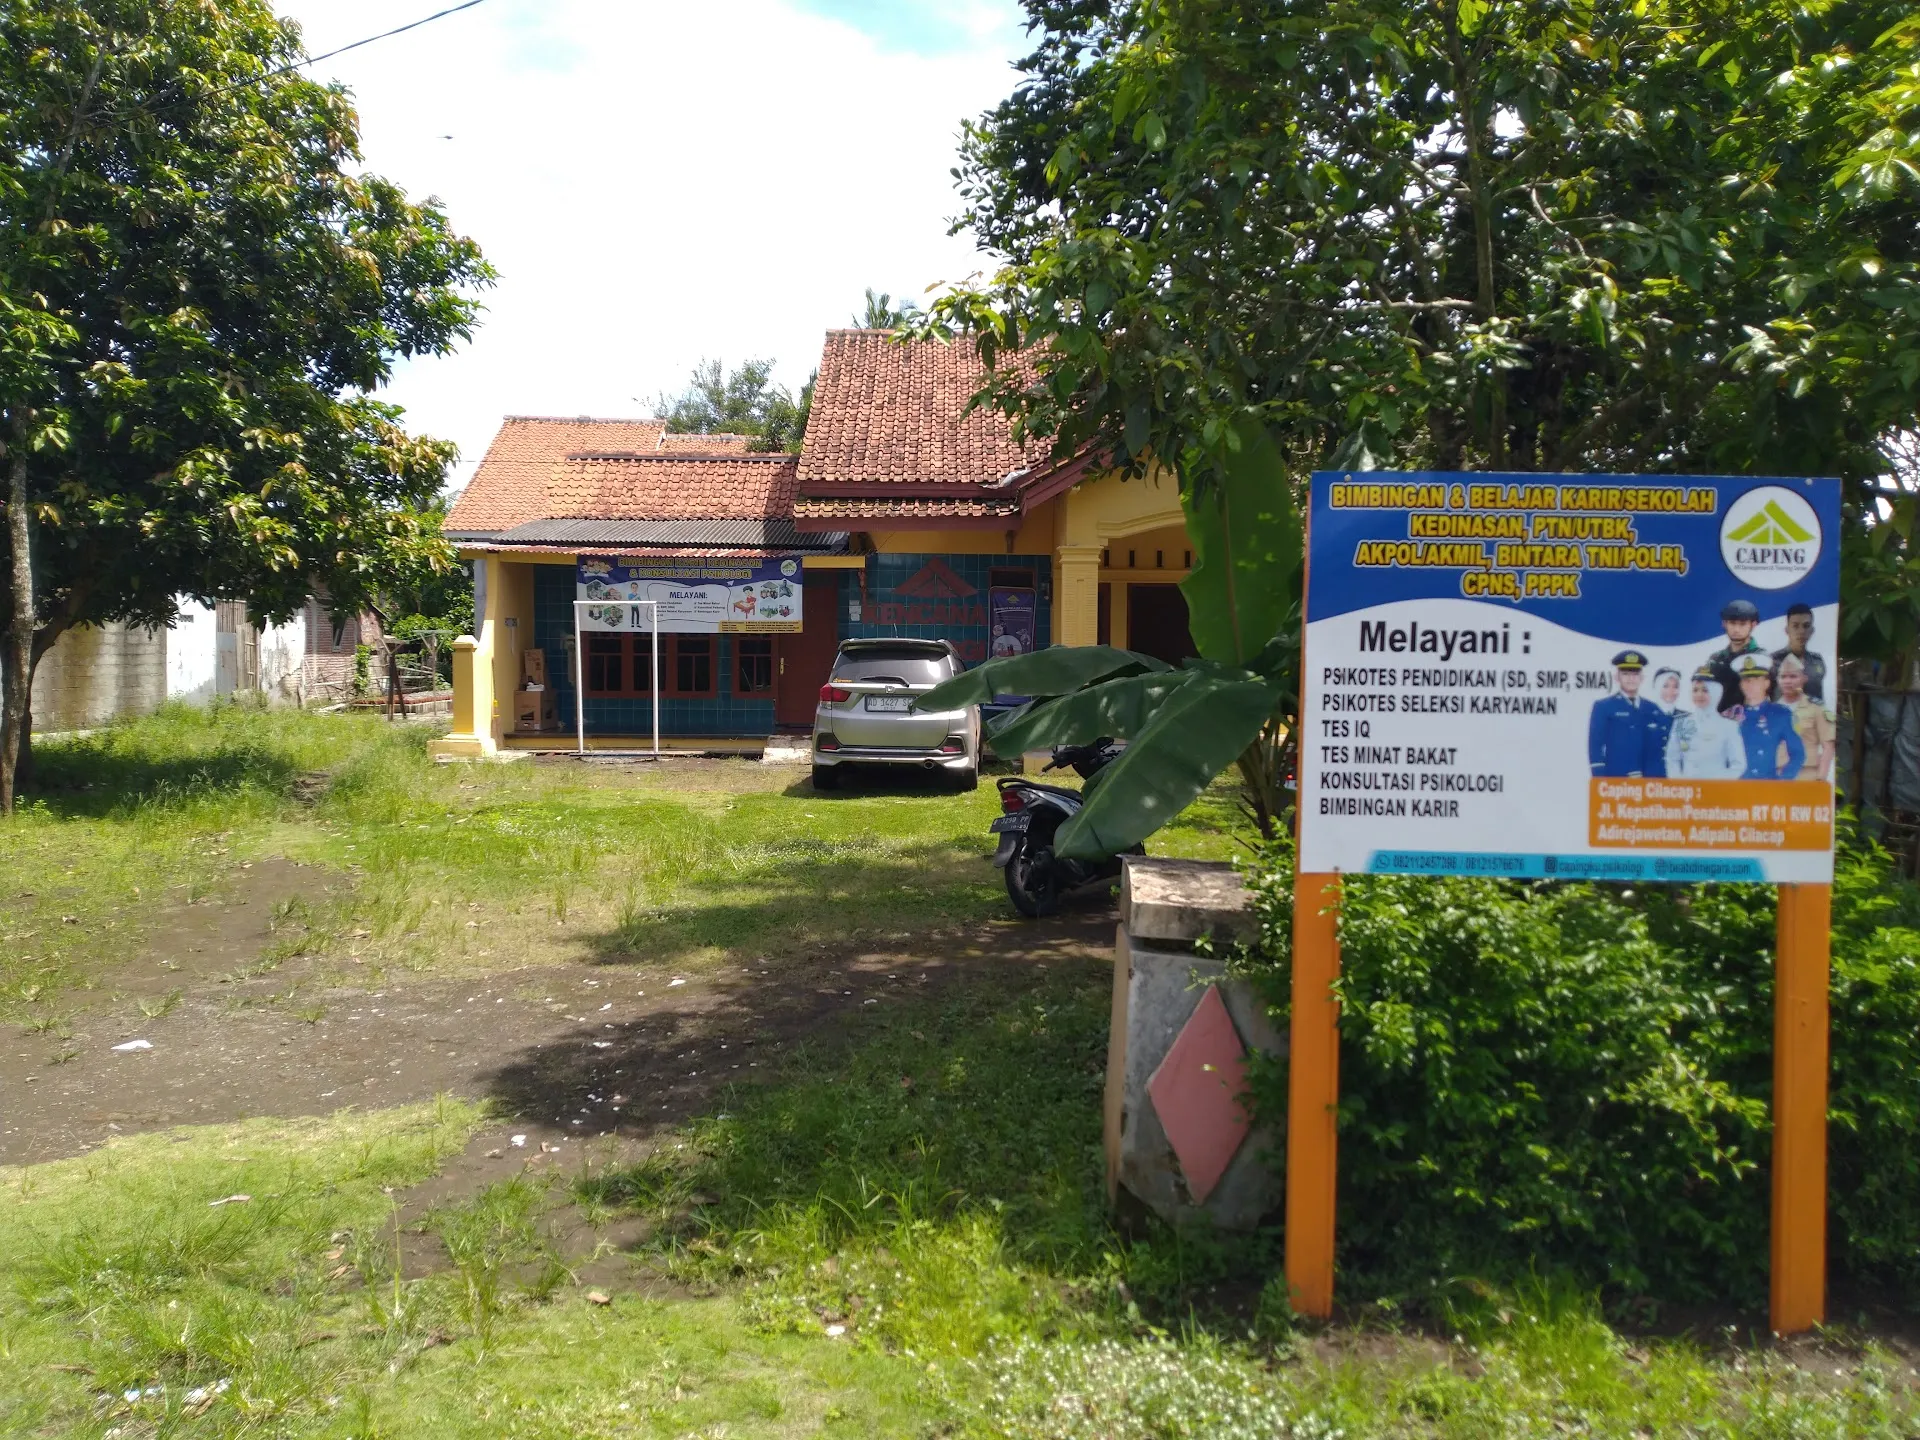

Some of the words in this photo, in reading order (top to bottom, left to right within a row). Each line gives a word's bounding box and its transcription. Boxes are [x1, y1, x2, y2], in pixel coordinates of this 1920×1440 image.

[1332, 485, 1445, 508] BIMBINGAN
[1449, 486, 1465, 509] &
[1469, 486, 1557, 510] BELAJAR
[1560, 488, 1715, 512] KARIR/SEKOLAH
[1411, 514, 1529, 542] KEDINASAN,
[1532, 516, 1636, 544] PTN/UTBK,
[1356, 542, 1492, 571] AKPOL/AKMIL,
[1496, 544, 1582, 568] BINTARA
[1586, 546, 1687, 574] TNI/POLRI,
[1735, 547, 1806, 565] CAPING
[702, 569, 753, 579] PSIKOLOGI
[669, 591, 708, 599] MELAYANI:
[1463, 572, 1521, 599] CPNS,
[1525, 574, 1580, 597] PPPK
[1360, 620, 1510, 661] Melayani
[1323, 667, 1397, 686] PSIKOTES
[1402, 669, 1496, 688] PENDIDIKAN
[1501, 670, 1531, 692] (SD,
[1536, 671, 1571, 692] SMP,
[1576, 671, 1612, 691] SMA)
[880, 698, 899, 707] 1427
[1322, 693, 1395, 712] PSIKOTES
[1401, 695, 1465, 713] SELEKSI
[1470, 697, 1557, 715] KARYAWAN
[1321, 720, 1349, 738] TES
[1354, 721, 1371, 740] IQ
[1321, 746, 1349, 764] TES
[1354, 746, 1402, 765] MINAT
[1406, 748, 1457, 766] BAKAT
[1320, 772, 1415, 790] KONSULTASI
[1420, 774, 1504, 792] PSIKOLOGI
[1598, 781, 1643, 801] Caping
[1645, 783, 1694, 802] Cilacap
[1320, 798, 1406, 816] BIMBINGAN
[1411, 799, 1460, 818] KARIR
[1751, 805, 1770, 821] RT
[1771, 806, 1787, 822] 01
[1814, 806, 1830, 822] 02
[1689, 826, 1736, 845] Adipala
[1738, 827, 1785, 846] Cilacap
